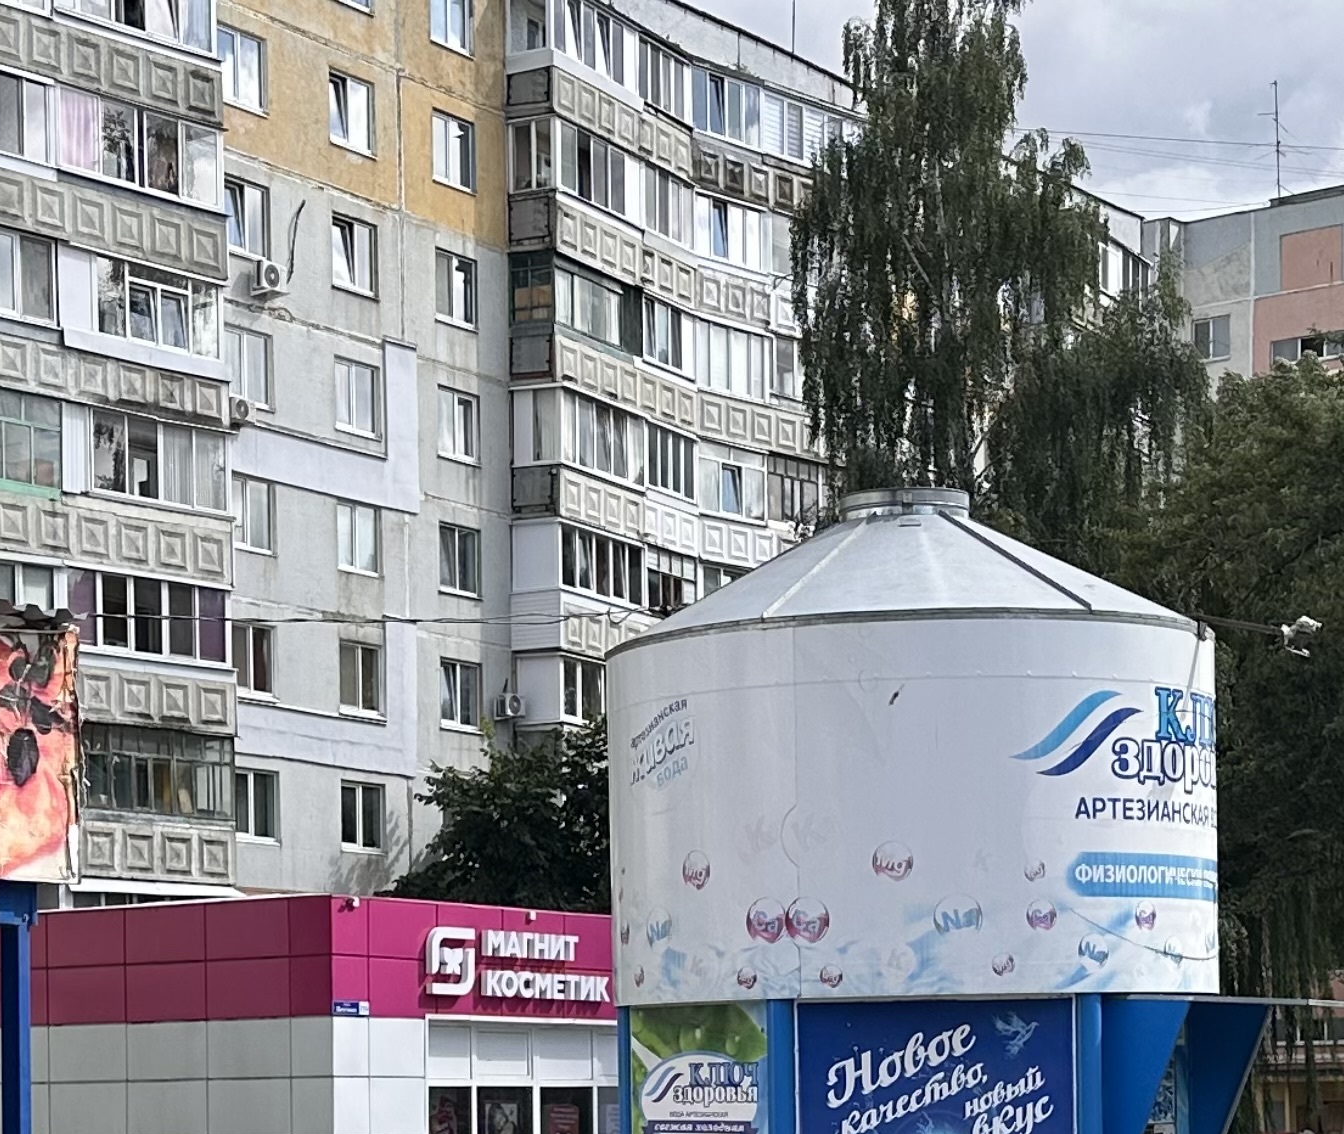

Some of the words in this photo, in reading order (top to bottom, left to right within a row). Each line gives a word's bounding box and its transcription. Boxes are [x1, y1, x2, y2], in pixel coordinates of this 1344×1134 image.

[1075, 797, 1210, 827] АРТЕЗИАНСКАЯ
[484, 930, 579, 962] МАГНИТ
[484, 971, 611, 1002] КОСМЕТИК
[689, 1062, 759, 1087] КЛЮЧ
[826, 1023, 978, 1109] Новое
[963, 1065, 1046, 1121] новый
